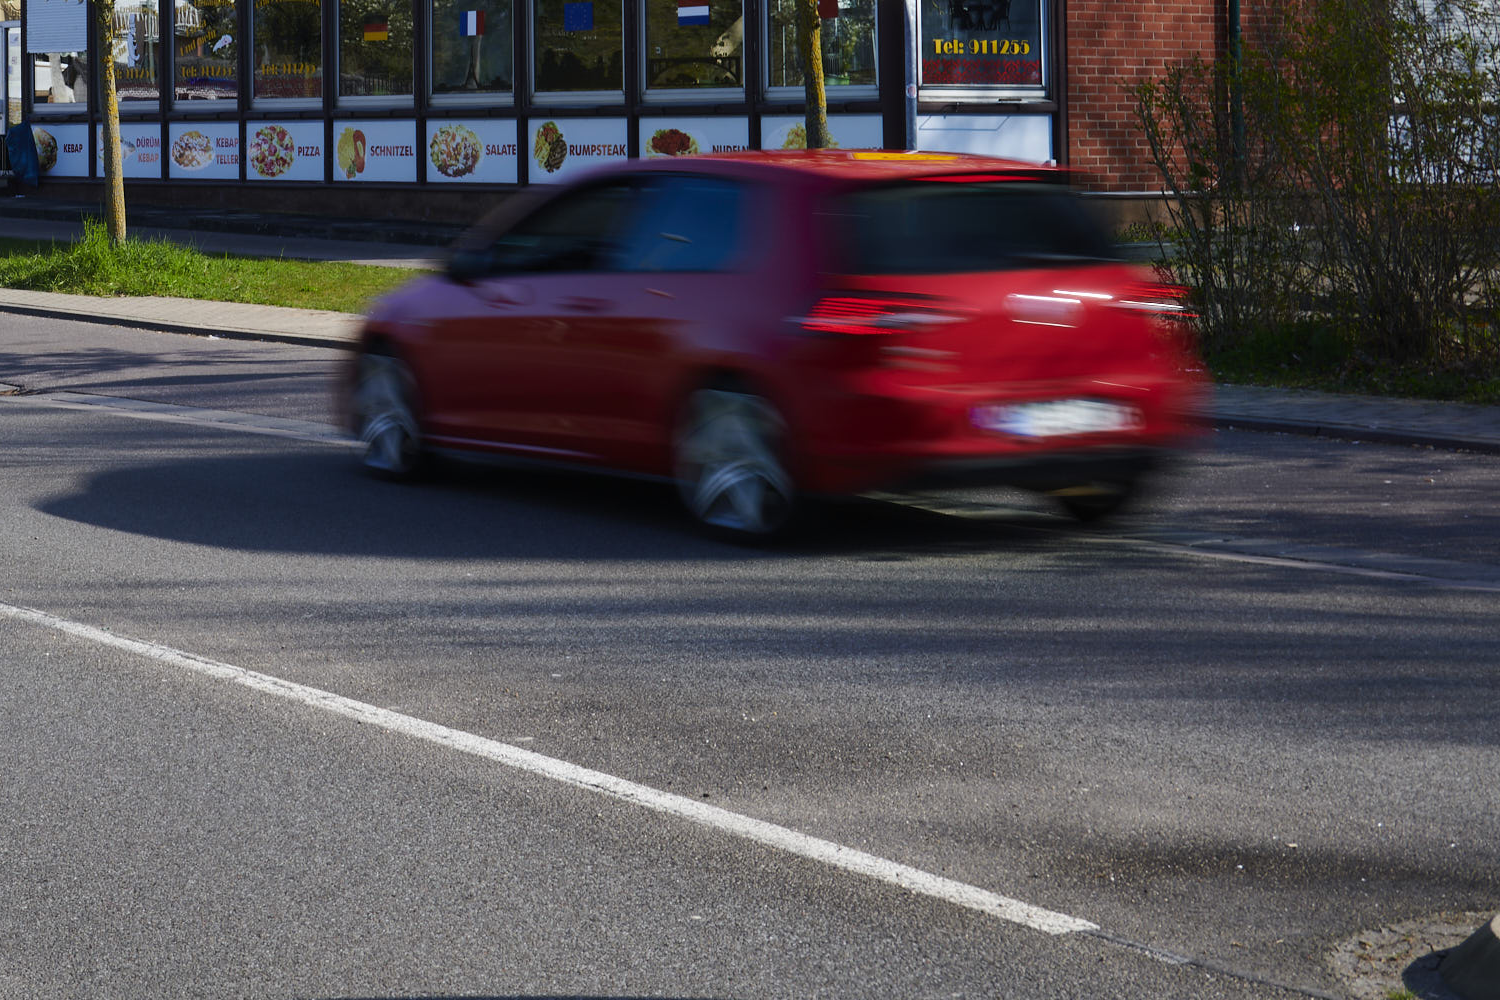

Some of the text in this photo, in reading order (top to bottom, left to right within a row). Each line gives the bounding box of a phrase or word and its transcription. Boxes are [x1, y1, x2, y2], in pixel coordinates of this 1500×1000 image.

[933, 39, 1030, 55] Tel: 911255
[136, 135, 160, 148] DÜRÜM
[216, 137, 239, 149] KEBAP
[63, 143, 83, 153] KEBAP
[298, 146, 320, 157] PIZZA
[370, 145, 414, 157] SCHNITZEL
[486, 144, 517, 156] SALATE
[569, 144, 626, 156] RUMPSTEAK
[137, 153, 159, 163] KEBAP
[216, 154, 239, 165] TELLER
